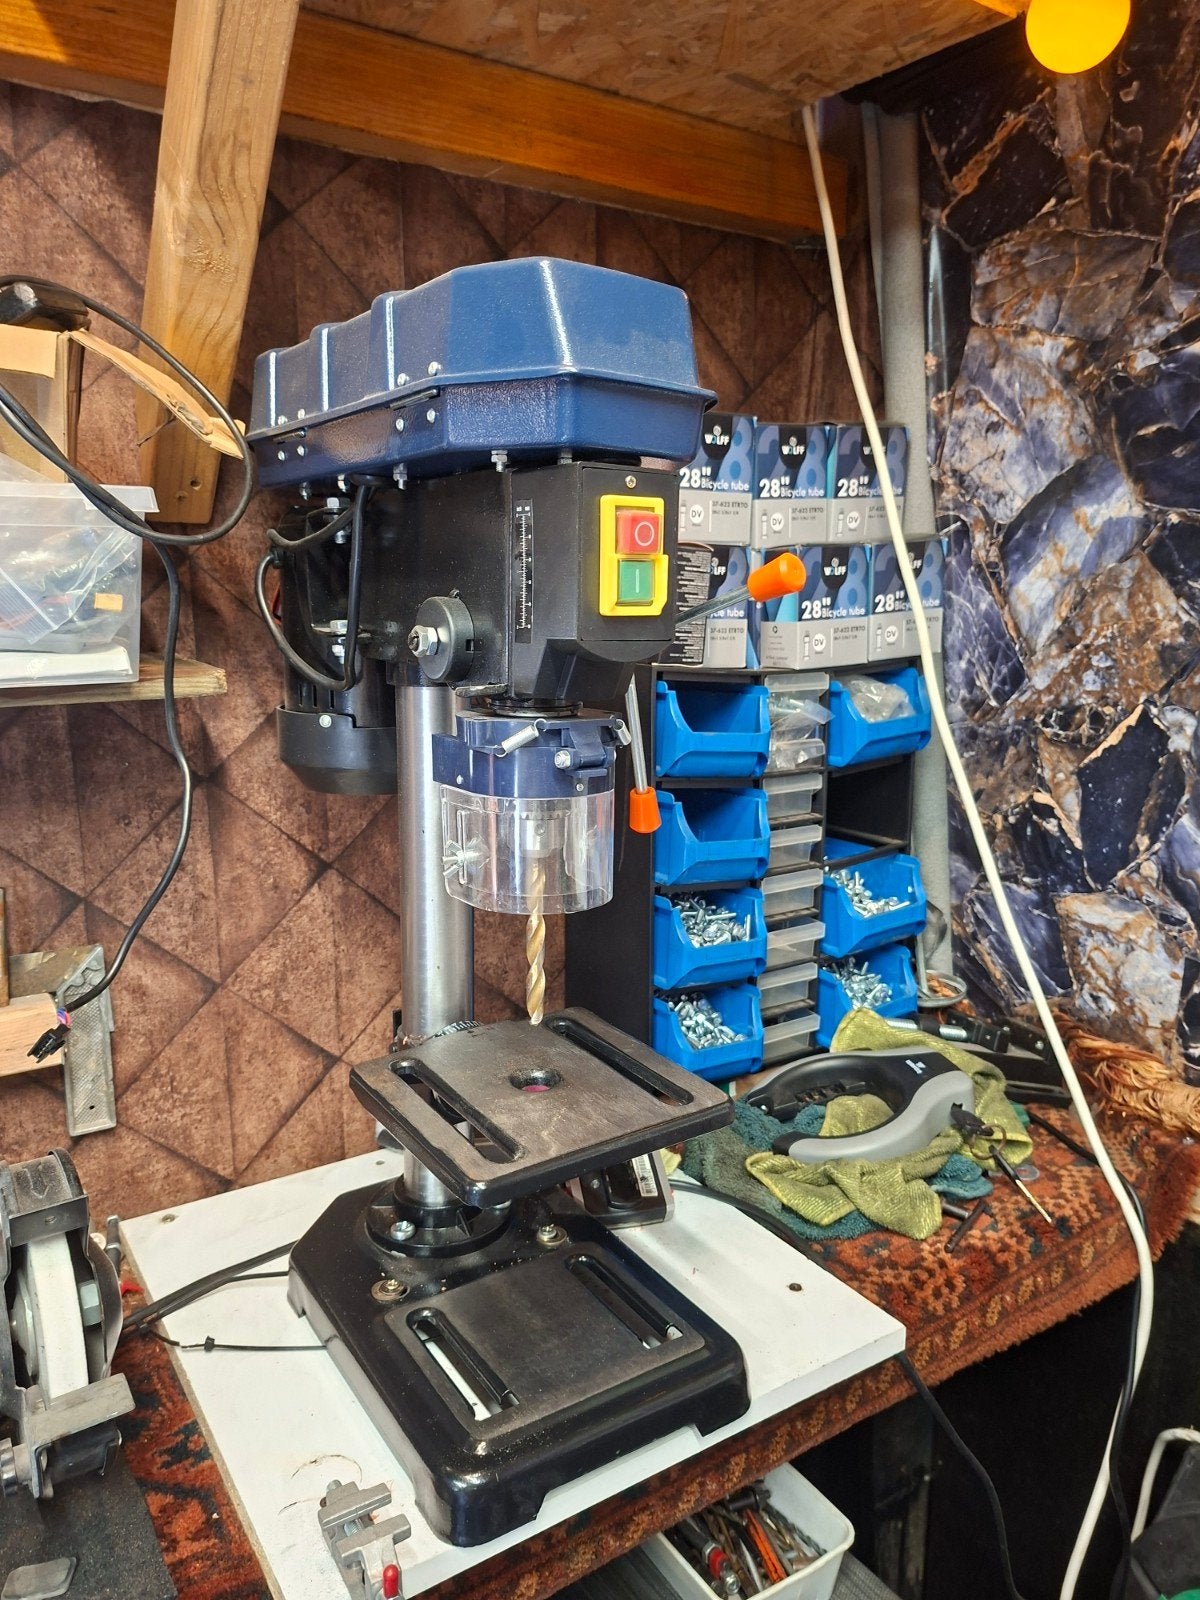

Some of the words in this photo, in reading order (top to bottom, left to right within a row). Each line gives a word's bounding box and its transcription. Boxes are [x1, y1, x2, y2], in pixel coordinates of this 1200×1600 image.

[704, 433, 730, 446] WOLFF
[781, 445, 805, 456] WOLFF
[679, 466, 712, 488] 28"
[701, 477, 729, 491] Bicycle
[731, 480, 750, 491] tube
[759, 476, 790, 498] 28"
[781, 487, 806, 499] Bicycle
[807, 487, 825, 497] tube
[837, 476, 869, 497] 28"
[691, 510, 702, 518] DV
[848, 516, 859, 524] DV
[772, 518, 783, 526] DV
[823, 565, 847, 576] WOLFF
[874, 590, 905, 613] 28"
[922, 598, 940, 607] tube
[727, 607, 745, 618] tube
[801, 597, 831, 619] 28"
[822, 607, 847, 619] Bicycle
[849, 606, 865, 616] tube
